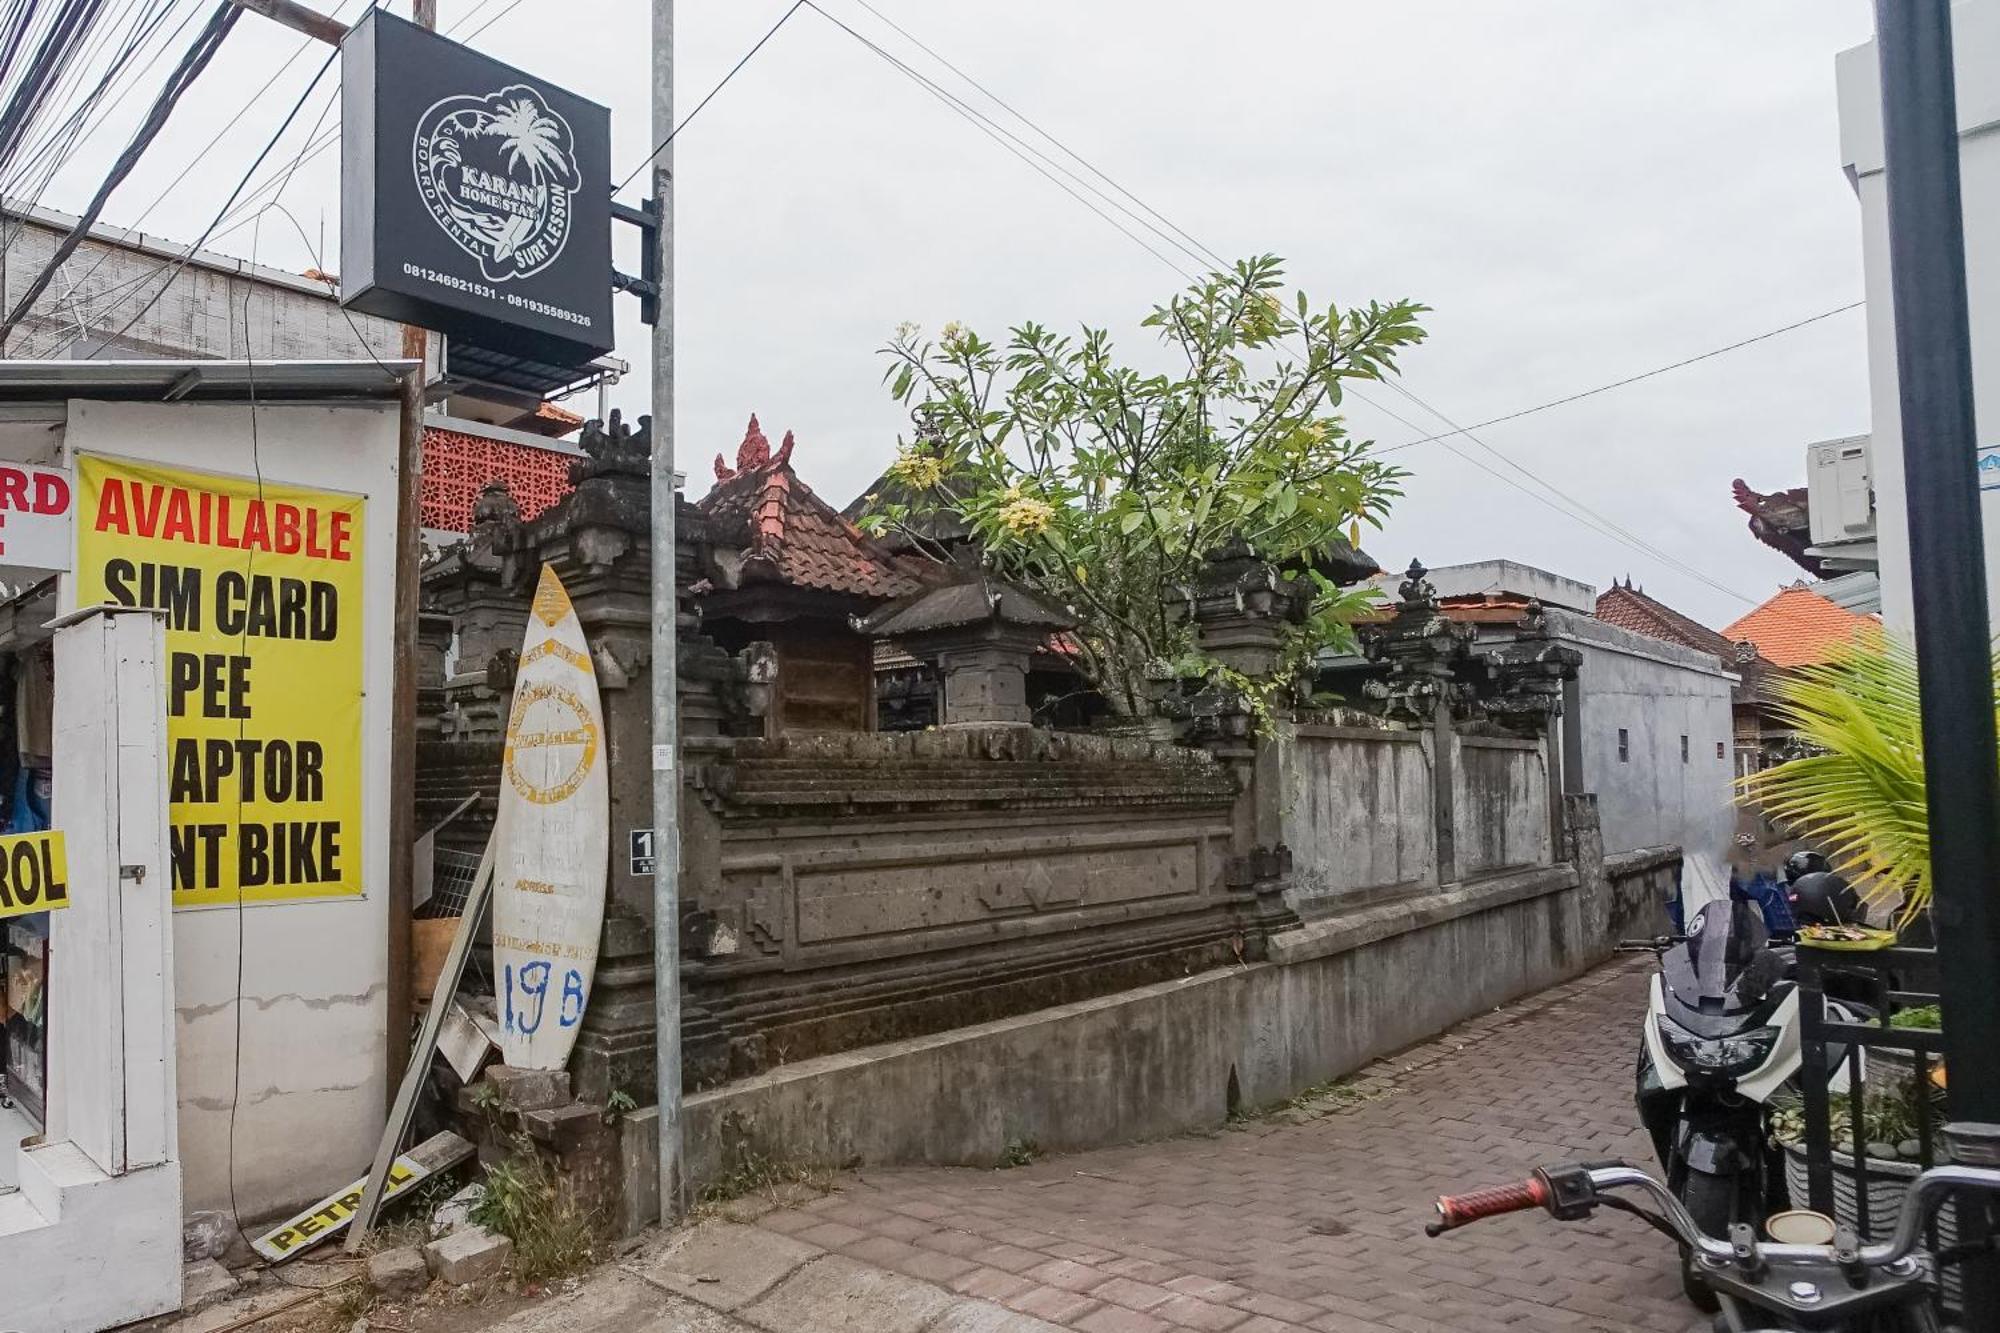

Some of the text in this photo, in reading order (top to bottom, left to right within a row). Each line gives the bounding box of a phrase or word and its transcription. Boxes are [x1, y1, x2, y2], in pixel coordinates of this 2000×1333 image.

[418, 137, 489, 257] BOARD RENTAL
[514, 183, 567, 268] SURF LESSON
[403, 263, 496, 299] 081246921531
[507, 294, 592, 327] 081935589326
[95, 478, 352, 562] AVAILABLE
[103, 558, 338, 641] SIM CARD
[167, 652, 251, 718] PEE
[170, 738, 323, 804] APTOR
[239, 821, 342, 887] BIKE
[638, 832, 652, 857] 1
[270, 1173, 417, 1251] PETRL
